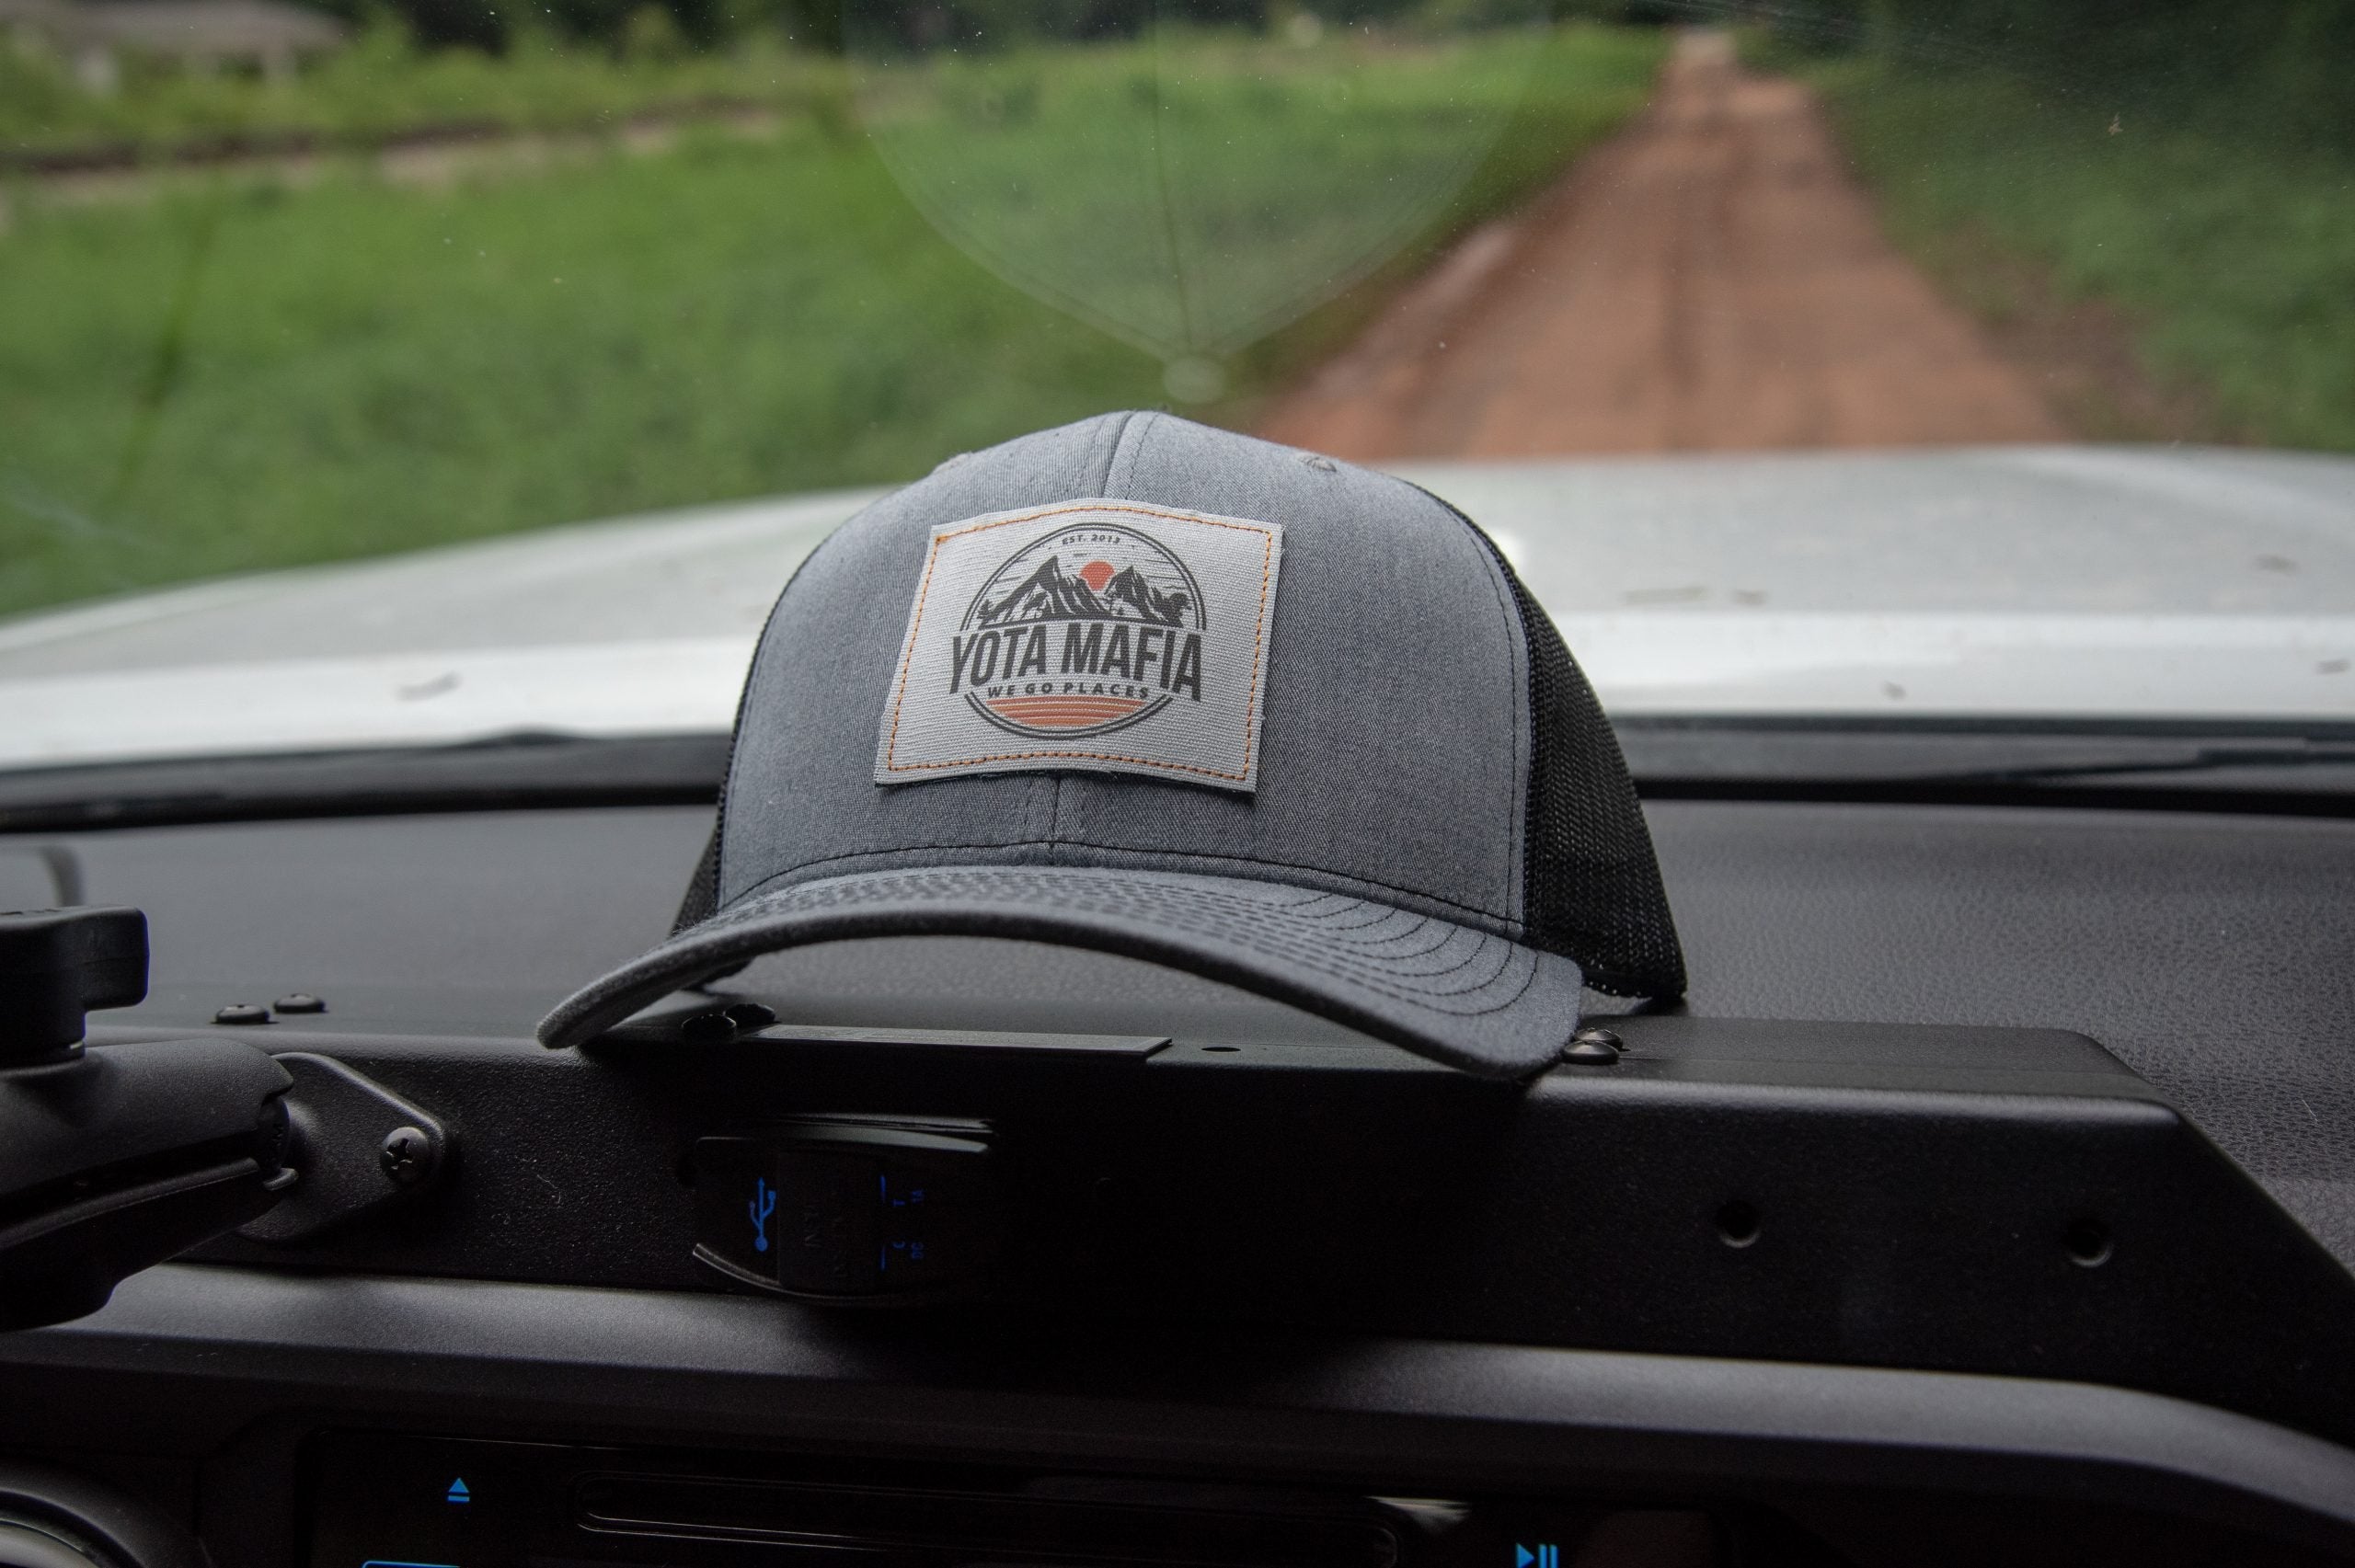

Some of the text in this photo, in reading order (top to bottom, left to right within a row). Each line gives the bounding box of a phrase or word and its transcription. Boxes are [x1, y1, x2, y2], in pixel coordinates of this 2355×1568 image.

[1063, 533, 1120, 545] EST. 2013
[949, 623, 1202, 702] YOTA MAFIA
[988, 682, 1149, 699] WE GO PLACES
